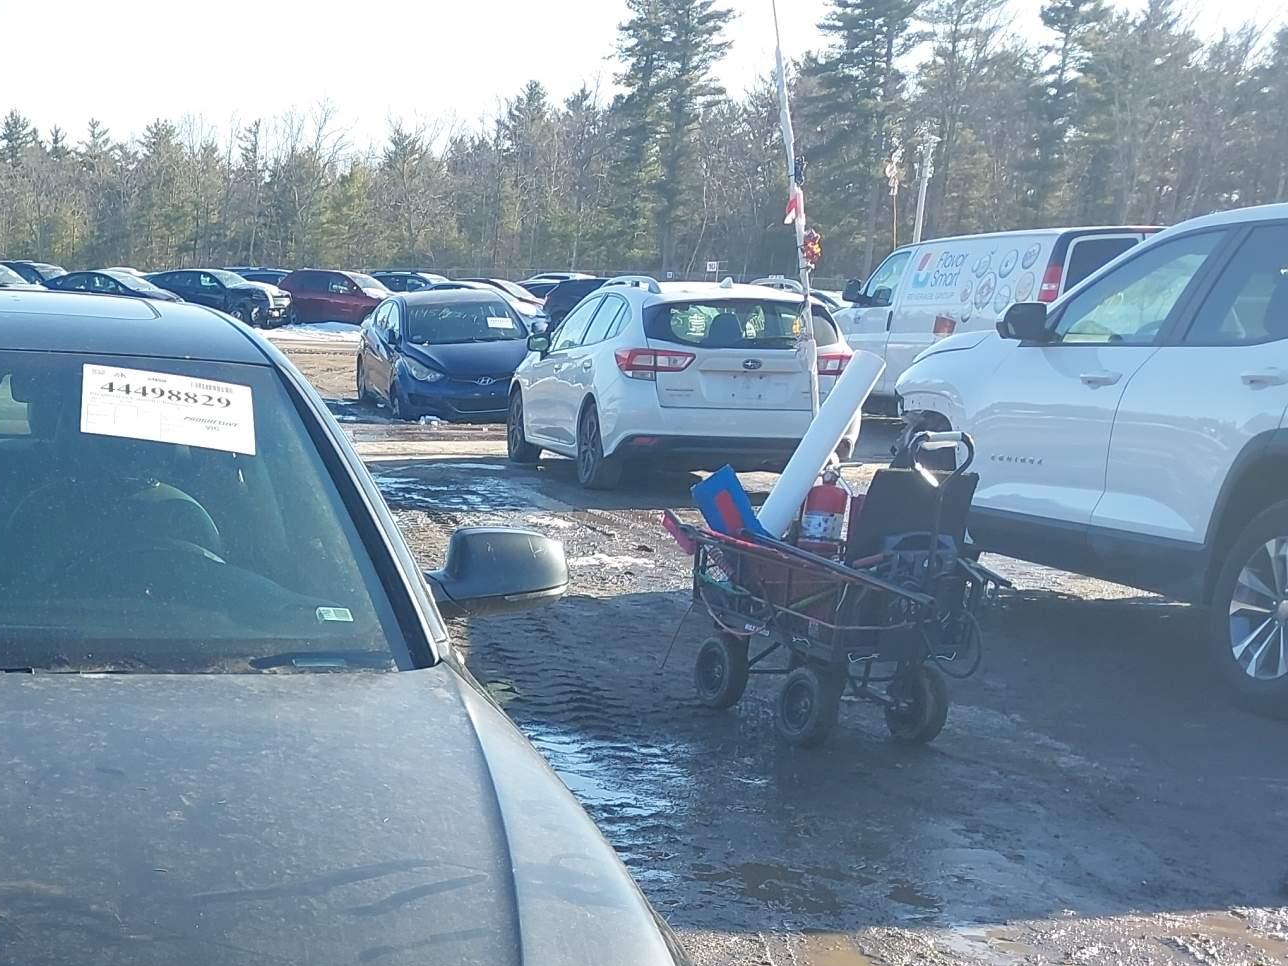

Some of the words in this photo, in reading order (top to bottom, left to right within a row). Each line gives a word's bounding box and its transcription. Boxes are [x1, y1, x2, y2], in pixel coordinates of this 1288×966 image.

[936, 251, 968, 268] Flavor
[930, 269, 961, 287] Smart
[100, 381, 232, 408] 44498829
